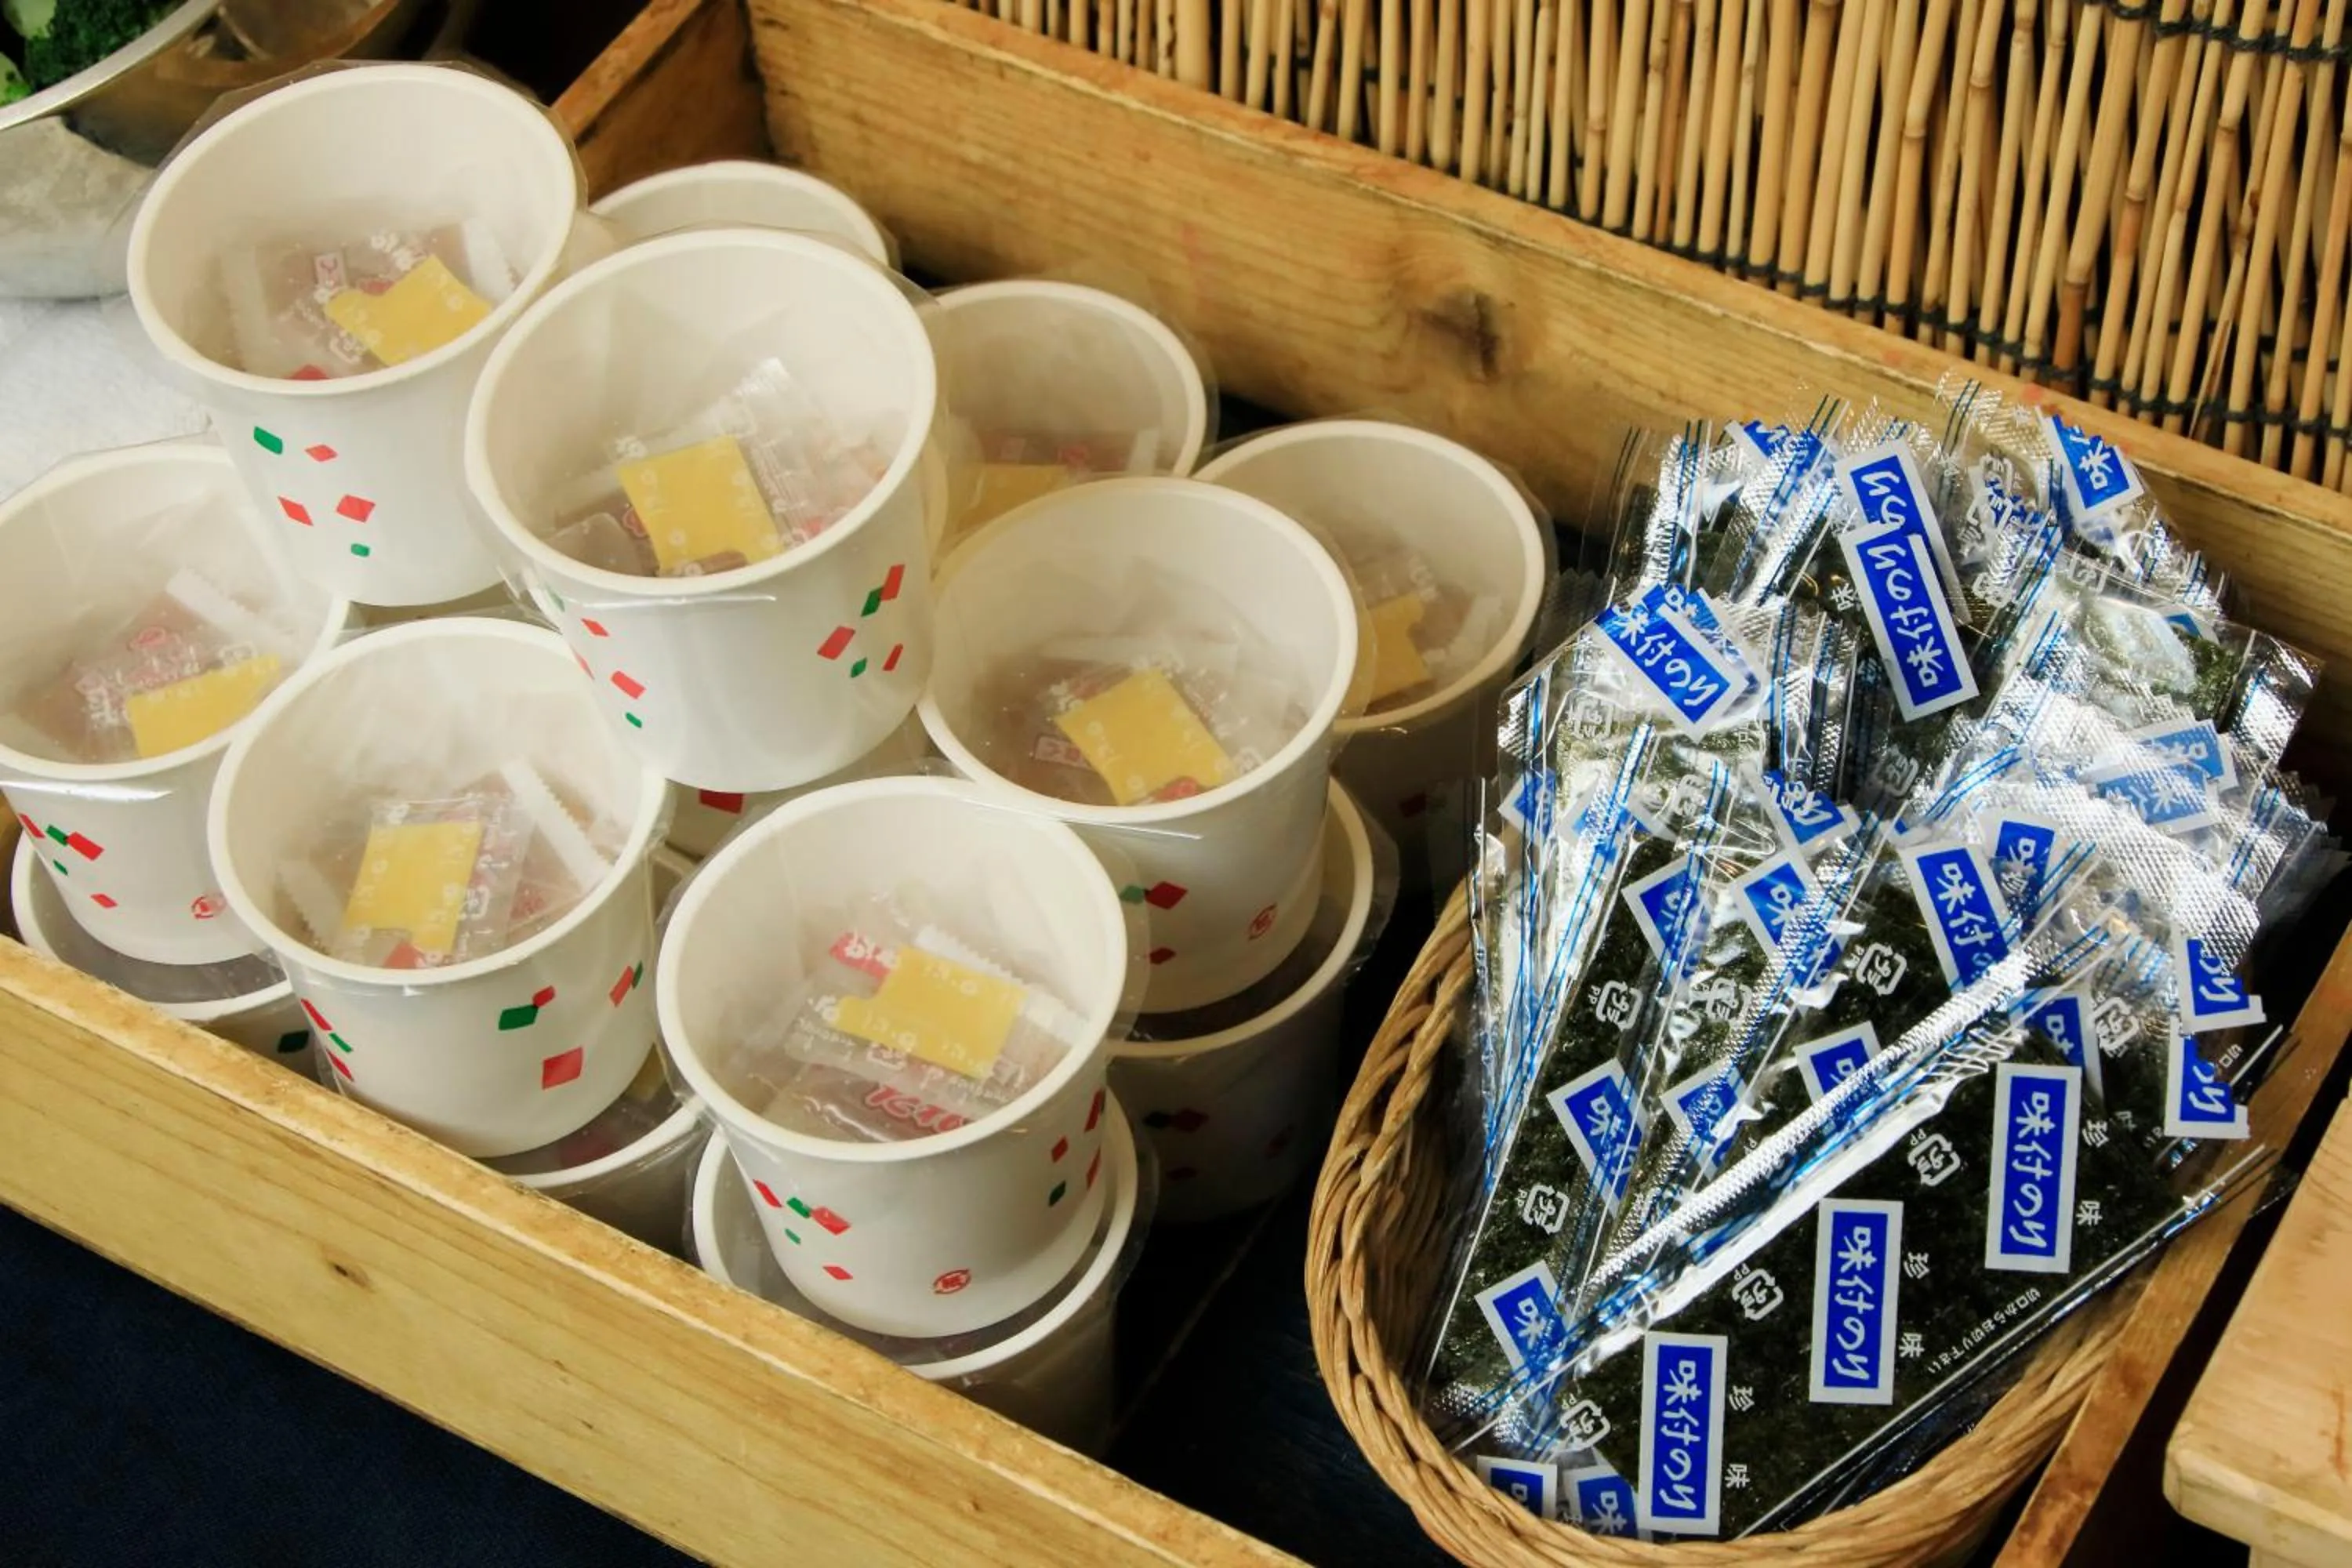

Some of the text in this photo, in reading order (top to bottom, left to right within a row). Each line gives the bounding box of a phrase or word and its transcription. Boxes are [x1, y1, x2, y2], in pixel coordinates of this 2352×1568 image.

[1867, 543, 1944, 688] 味付のり
[2009, 1091, 2056, 1248] 味付のり
[1832, 1226, 1877, 1380] 味付のり
[1659, 1360, 1703, 1511] 味付のり
